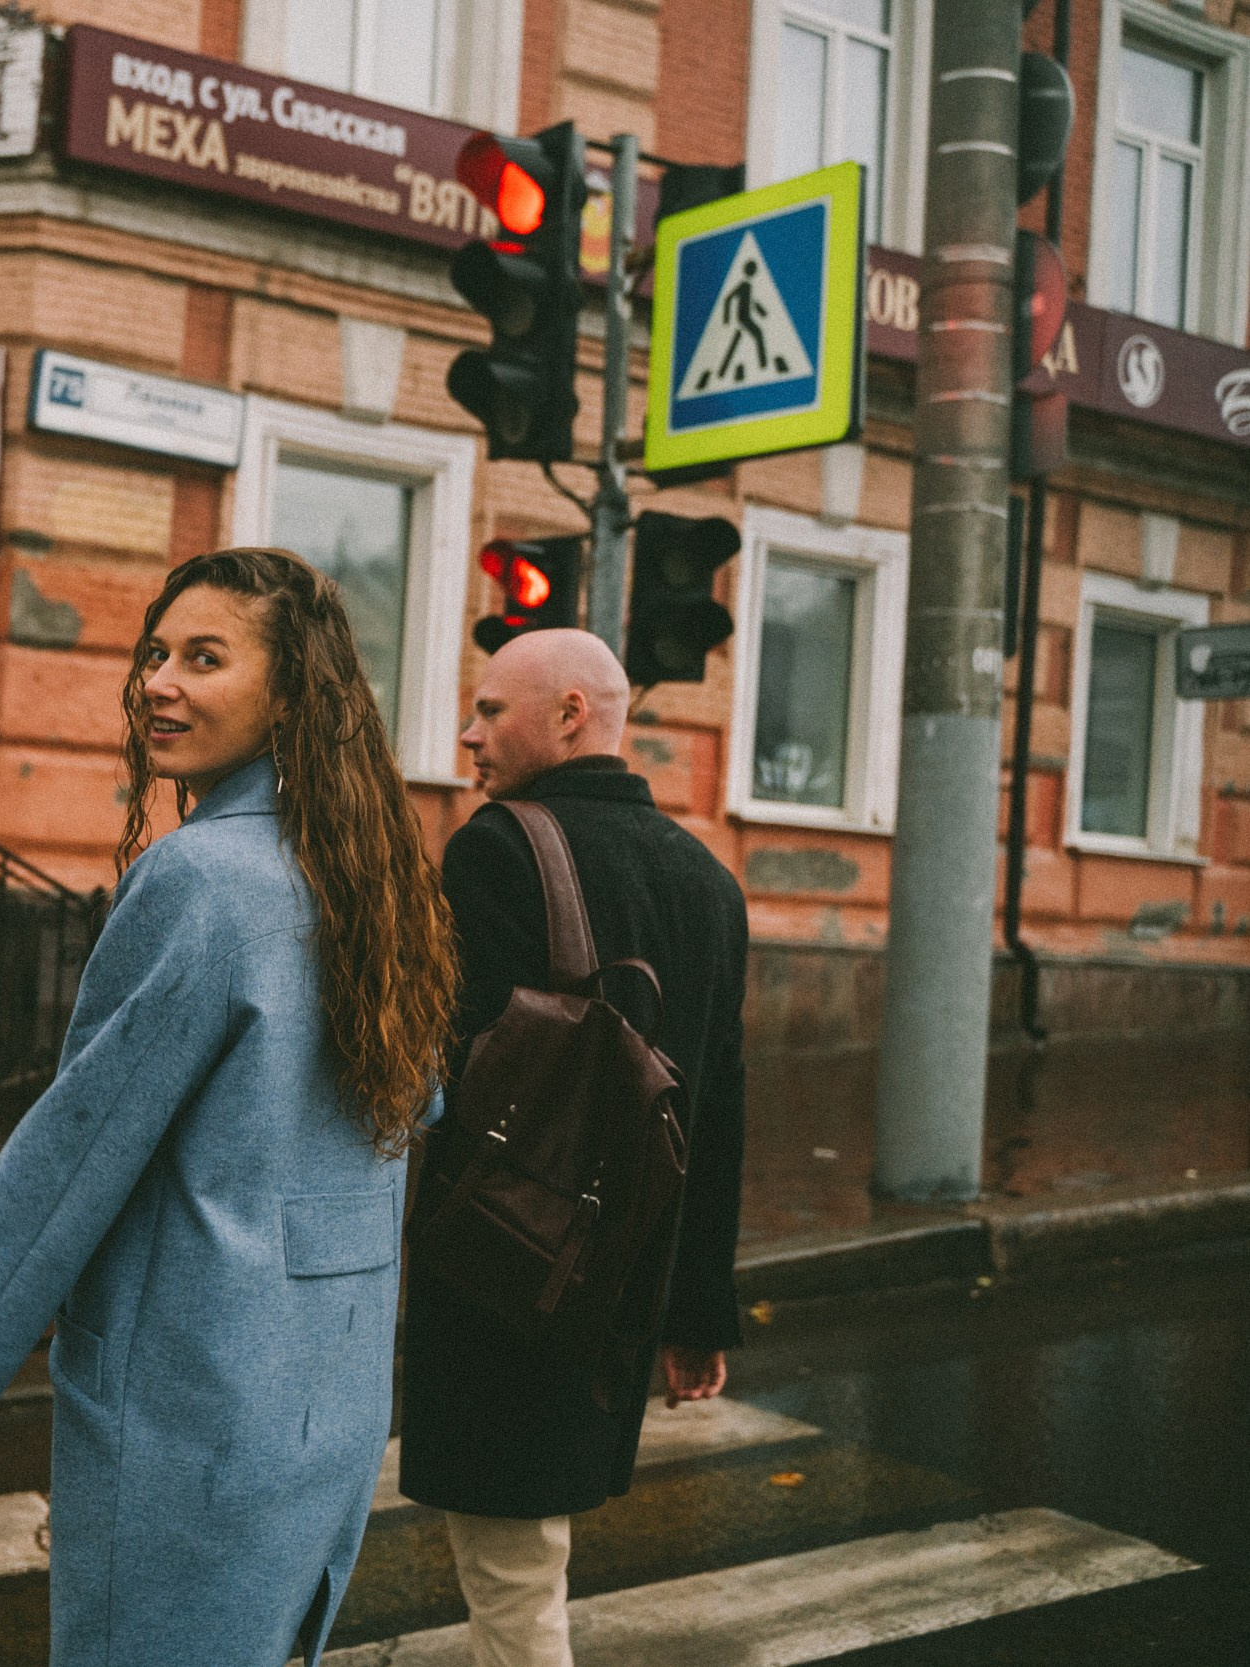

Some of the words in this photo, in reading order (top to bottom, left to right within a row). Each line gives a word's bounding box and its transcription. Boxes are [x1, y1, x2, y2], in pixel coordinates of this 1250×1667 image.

[105, 95, 229, 175] МЕХА
[111, 53, 194, 109] вход
[199, 82, 221, 110] с
[221, 84, 269, 125] ул.
[271, 85, 407, 157] Спасская
